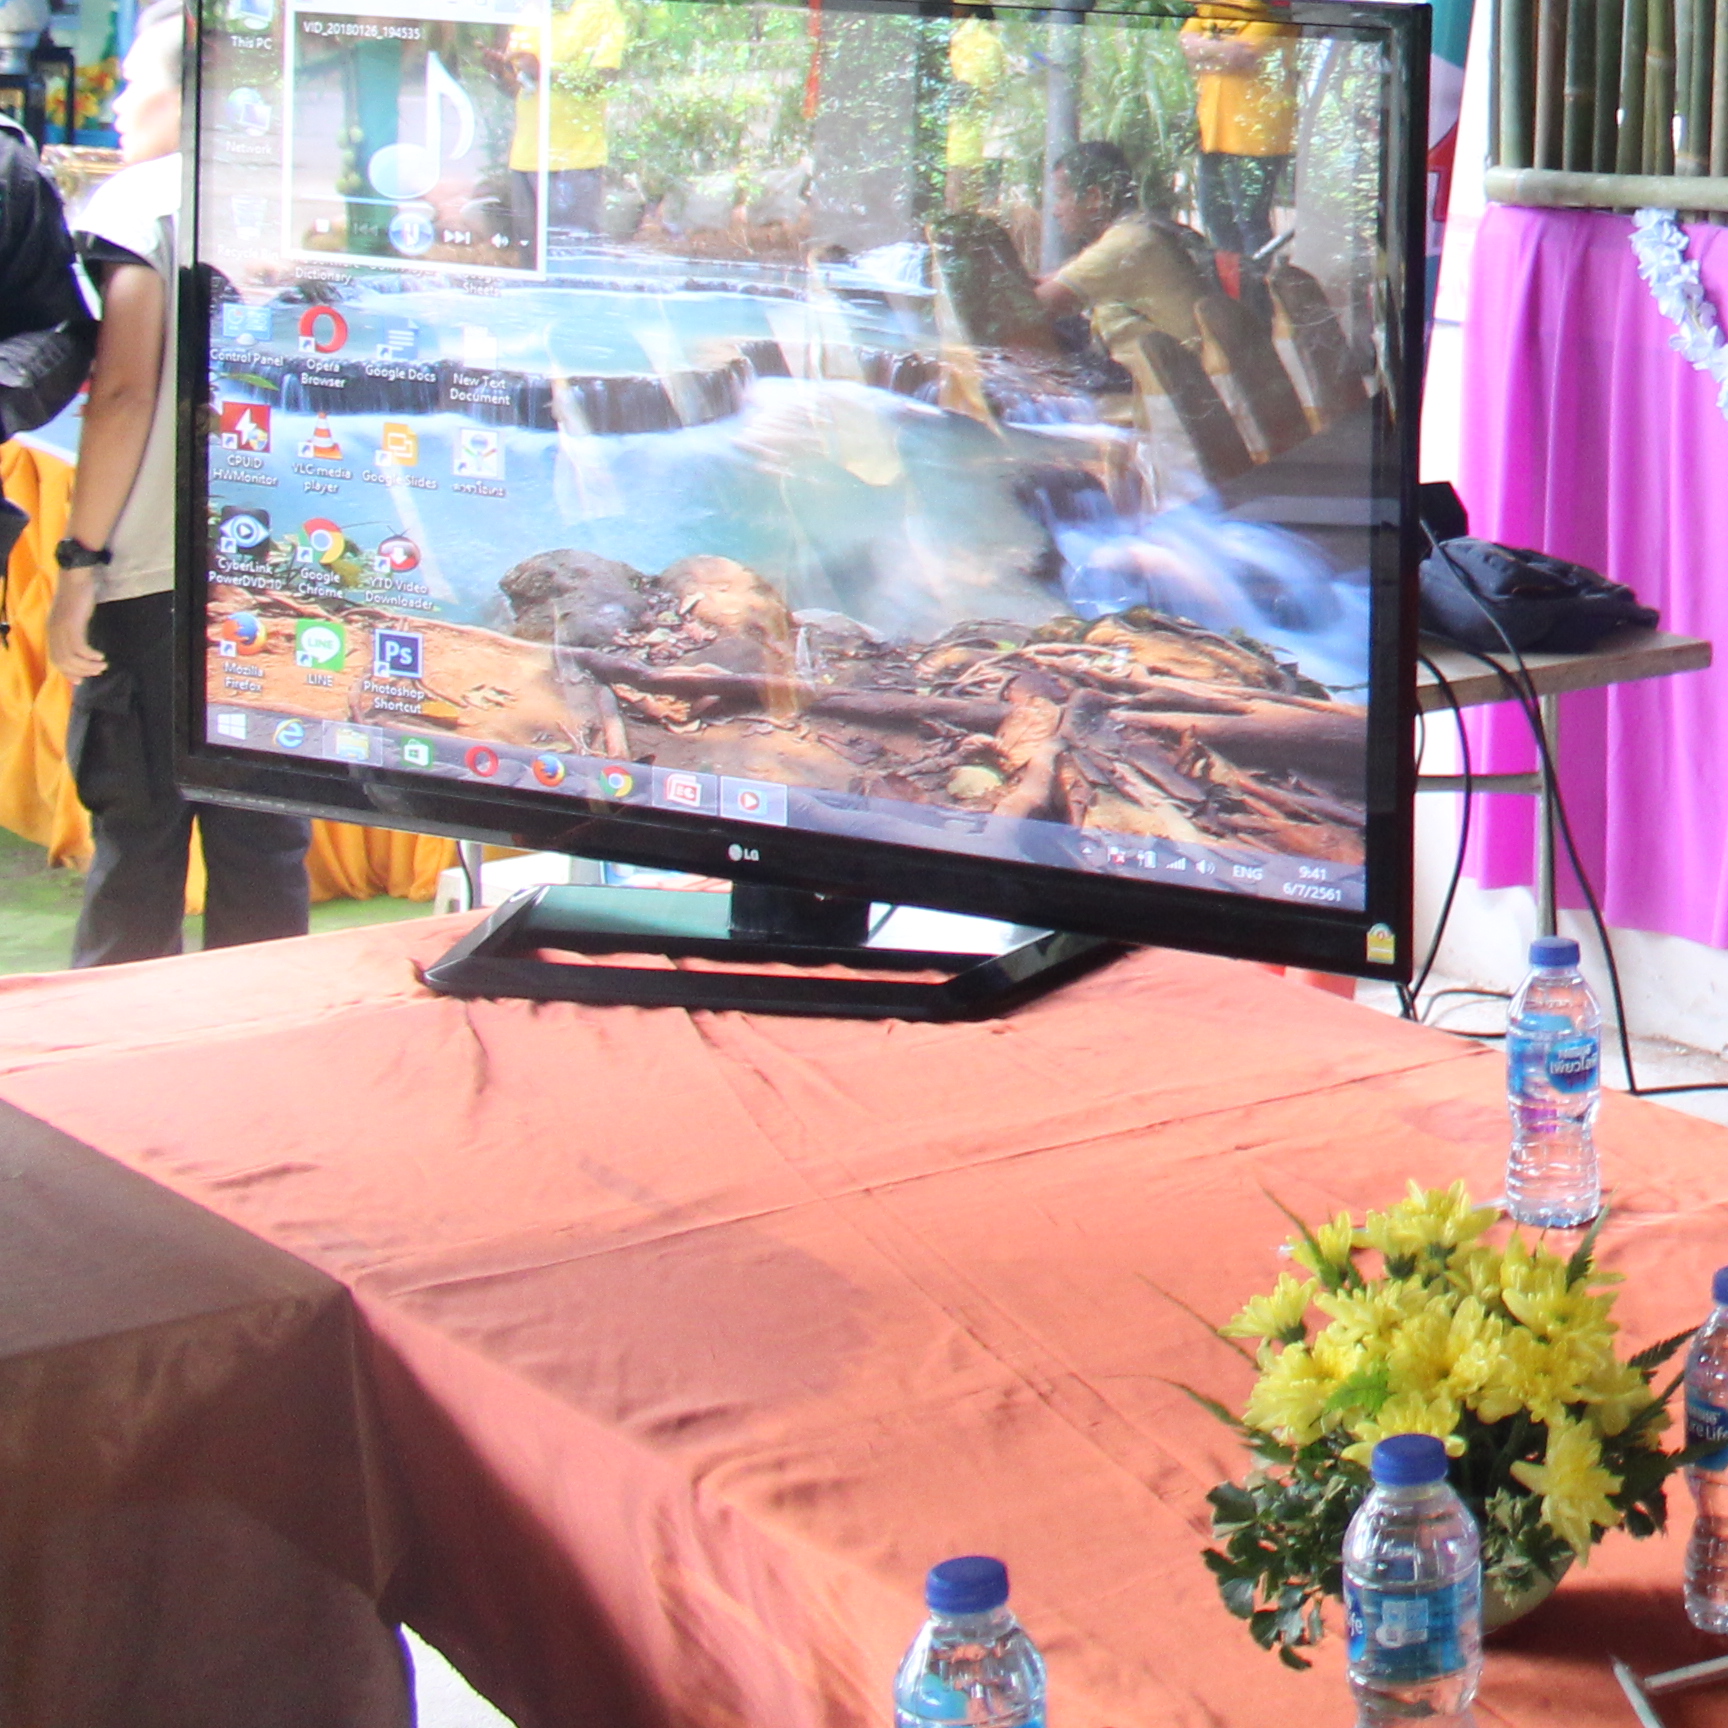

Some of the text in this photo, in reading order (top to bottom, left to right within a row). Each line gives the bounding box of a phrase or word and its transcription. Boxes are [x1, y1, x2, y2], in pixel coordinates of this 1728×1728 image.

[303, 20, 421, 40] VID_20180126_194535
[231, 35, 272, 51] This PC
[226, 141, 272, 156] Network
[295, 267, 352, 285] Dictionary
[463, 282, 500, 298] Sheets
[210, 350, 284, 368] Control Panel
[306, 358, 340, 376] Opera
[301, 372, 345, 388] Browser
[365, 363, 436, 383] Google Docs
[453, 372, 506, 389] New Text
[450, 388, 510, 405] Document
[227, 454, 262, 469] CPUID
[214, 468, 278, 486] HWMonitor
[292, 463, 352, 480] VLC media
[362, 470, 437, 489] Google Slides
[304, 478, 339, 495] player
[218, 556, 272, 575] CyberLink
[209, 572, 267, 590] PowerDVD
[300, 568, 340, 585] Google
[369, 576, 428, 594] YTD Video
[299, 583, 343, 600] Chrome
[365, 592, 434, 611] Downloader
[308, 636, 334, 650] LINE
[385, 640, 412, 666] Ps
[224, 663, 264, 678] Mozilla
[225, 677, 262, 693] Firefox
[307, 674, 333, 687] LINE
[363, 681, 425, 701] Photoshop
[374, 697, 421, 714] Shortcut
[744, 849, 759, 861] LG
[1232, 865, 1263, 880] ENG
[1299, 866, 1326, 881] 9:41
[1284, 882, 1342, 902] 6/7/2561
